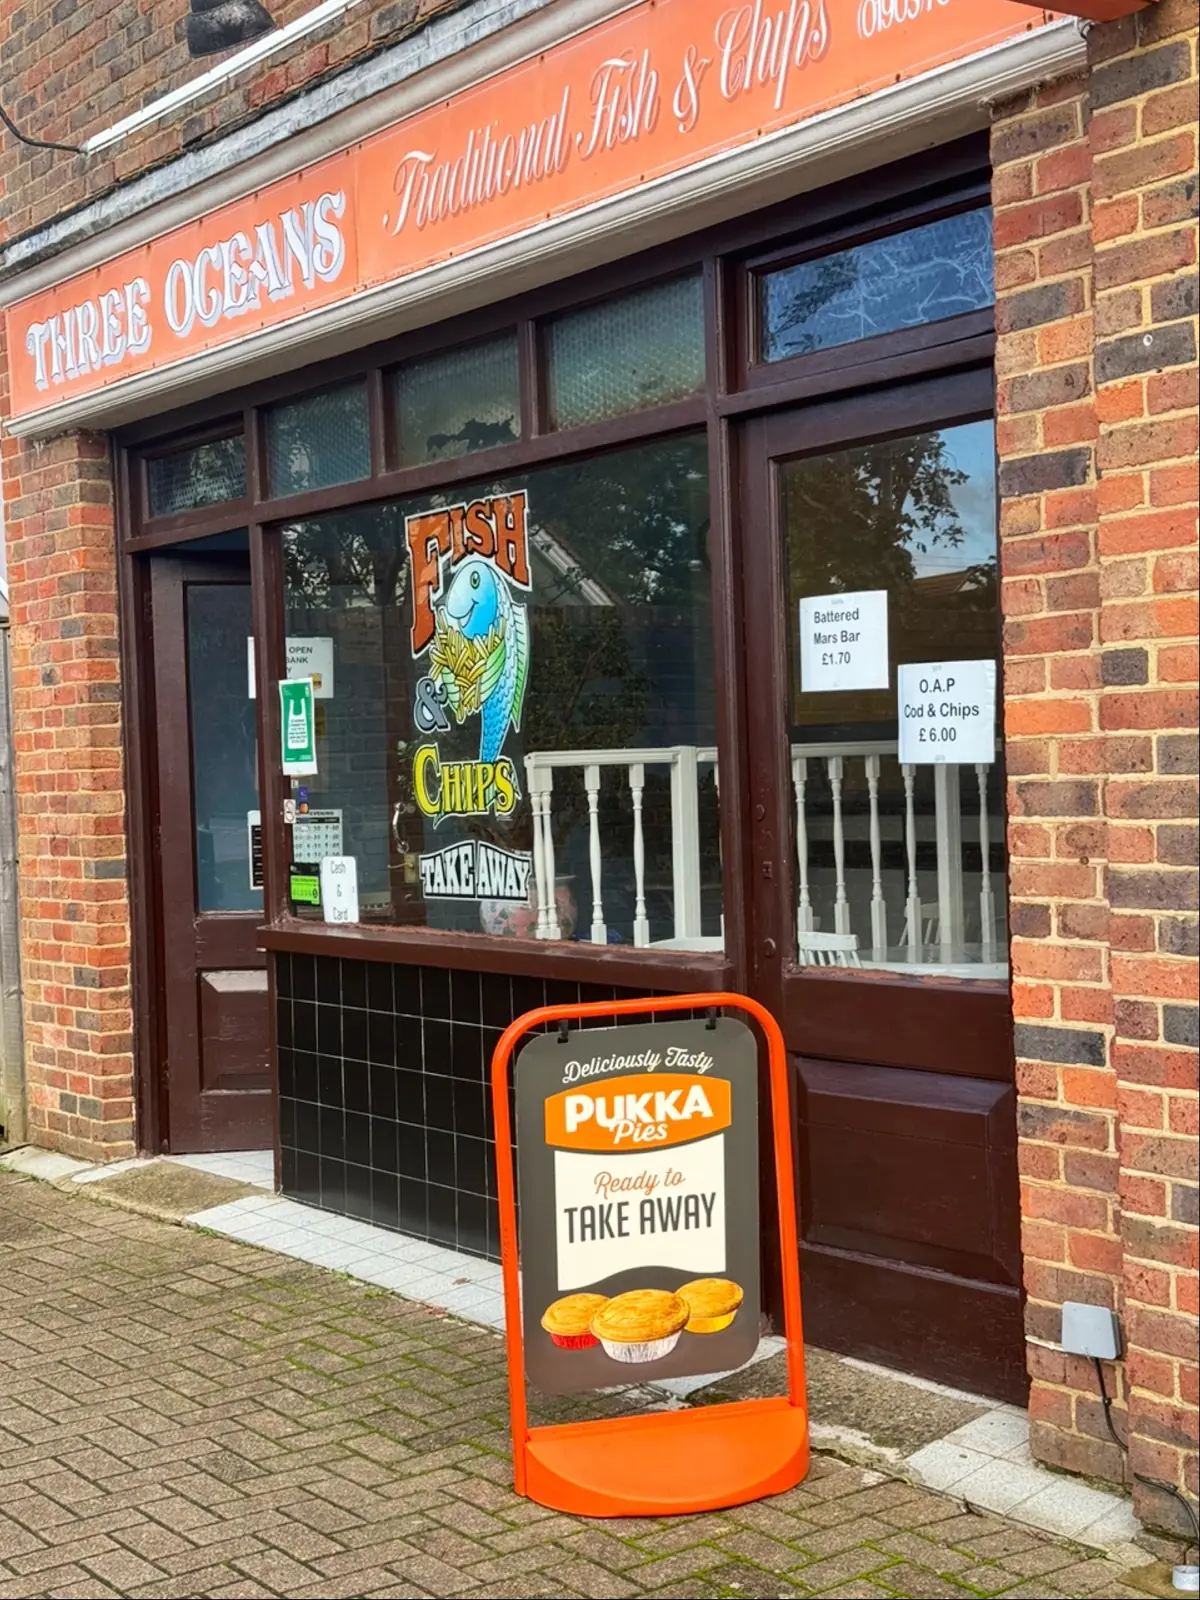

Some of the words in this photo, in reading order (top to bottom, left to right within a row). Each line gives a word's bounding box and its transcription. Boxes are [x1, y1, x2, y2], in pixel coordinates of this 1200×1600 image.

[383, 85, 572, 236] Traditional
[576, 48, 661, 161] Fish
[671, 44, 713, 133] &
[714, 0, 828, 110] Chips
[26, 277, 152, 391] THREE
[164, 189, 346, 338] OCEANS
[406, 490, 532, 658] FISH
[813, 608, 860, 624] Battered
[288, 646, 313, 654] OPEN
[813, 632, 838, 645] Mars
[840, 630, 861, 643] Bar
[821, 652, 851, 666] £1.70
[919, 677, 956, 694] O.A.P
[414, 676, 450, 733] &
[904, 704, 924, 718] Cod
[927, 703, 936, 718] &
[939, 702, 980, 720] Chips
[413, 744, 517, 817] CHIPS
[330, 860, 346, 874] Cash
[422, 844, 475, 897] TAKE
[477, 846, 531, 899] AWAY
[332, 907, 349, 921] Card
[562, 1049, 662, 1084] Deliciously
[664, 1046, 714, 1074] Tasty
[564, 1084, 714, 1133] PUKKA
[613, 1120, 669, 1144] Pies
[594, 1170, 660, 1200] Ready
[663, 1167, 686, 1187] to
[564, 1201, 630, 1244] TAKE
[639, 1192, 717, 1236] AWAY
